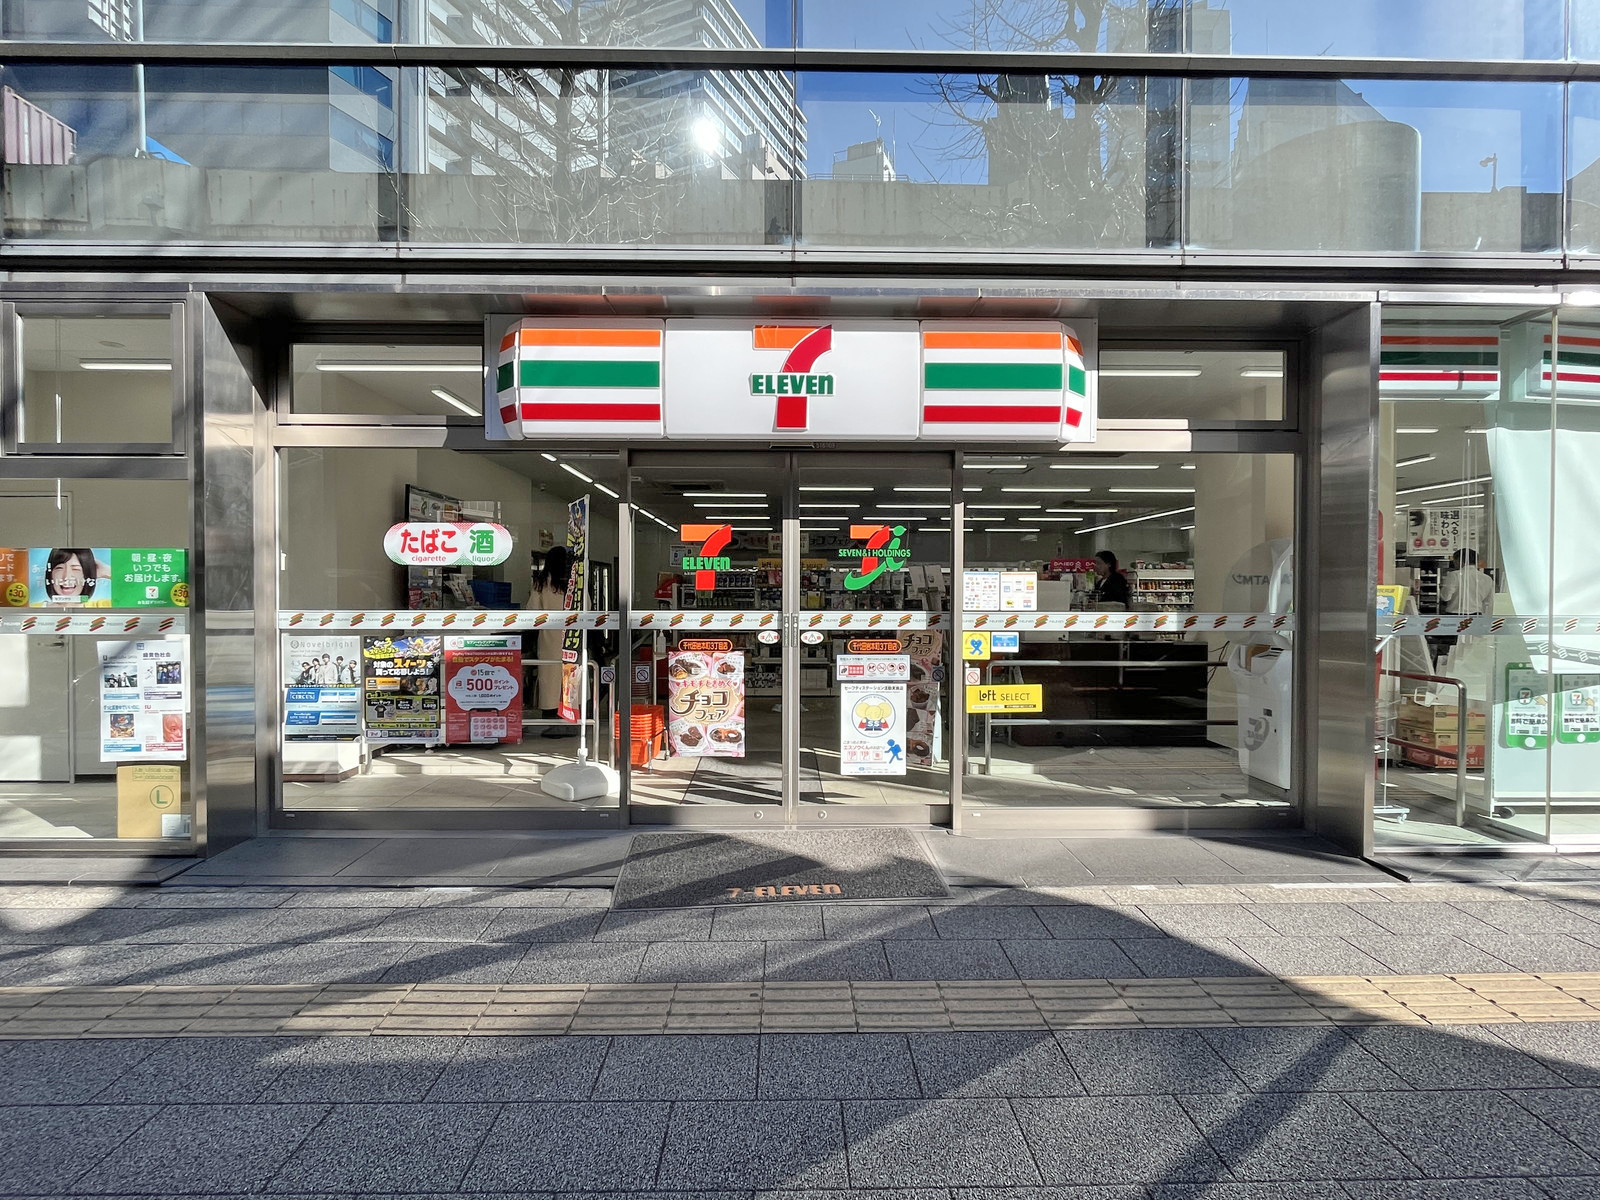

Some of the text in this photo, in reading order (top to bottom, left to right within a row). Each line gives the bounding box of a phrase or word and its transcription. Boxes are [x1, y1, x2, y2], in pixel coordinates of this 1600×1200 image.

[400, 529, 458, 554] たばこ
[469, 529, 495, 554] 酒
[131, 553, 172, 563] 朝・昼・夜
[872, 548, 912, 558] HOLDINGS
[411, 555, 447, 563] cigarette
[472, 555, 495, 563] liquor
[133, 563, 171, 572] いつでも
[124, 574, 182, 583] お届けします。
[466, 678, 493, 691] 500
[1000, 692, 1031, 701] SELECT
[670, 689, 729, 715] チョコ
[156, 790, 168, 804] L
